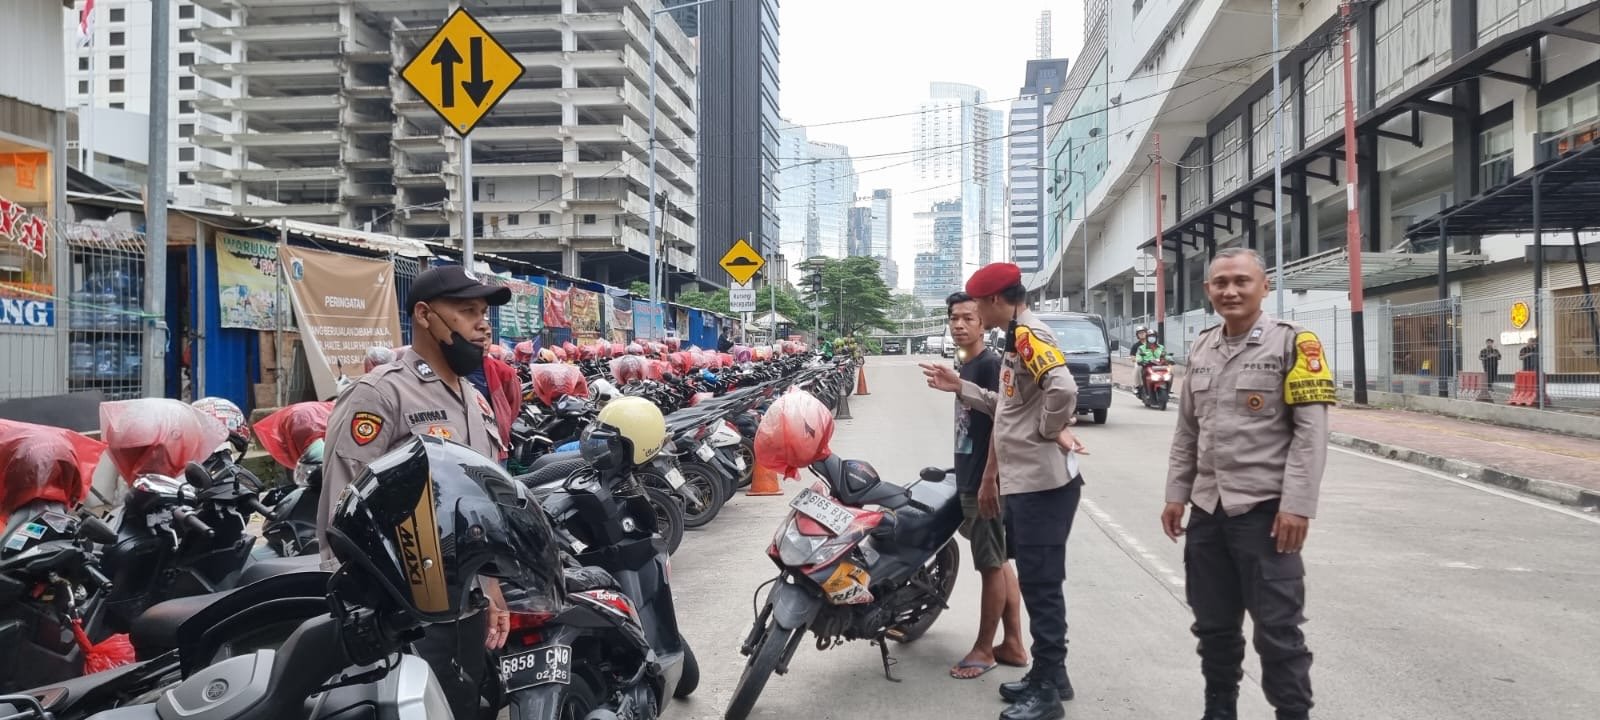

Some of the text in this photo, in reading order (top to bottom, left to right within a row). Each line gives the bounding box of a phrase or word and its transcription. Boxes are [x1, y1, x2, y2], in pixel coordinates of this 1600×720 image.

[324, 295, 366, 309] PERINGATAN
[399, 525, 423, 585] MAXI
[501, 653, 536, 674] 6858
